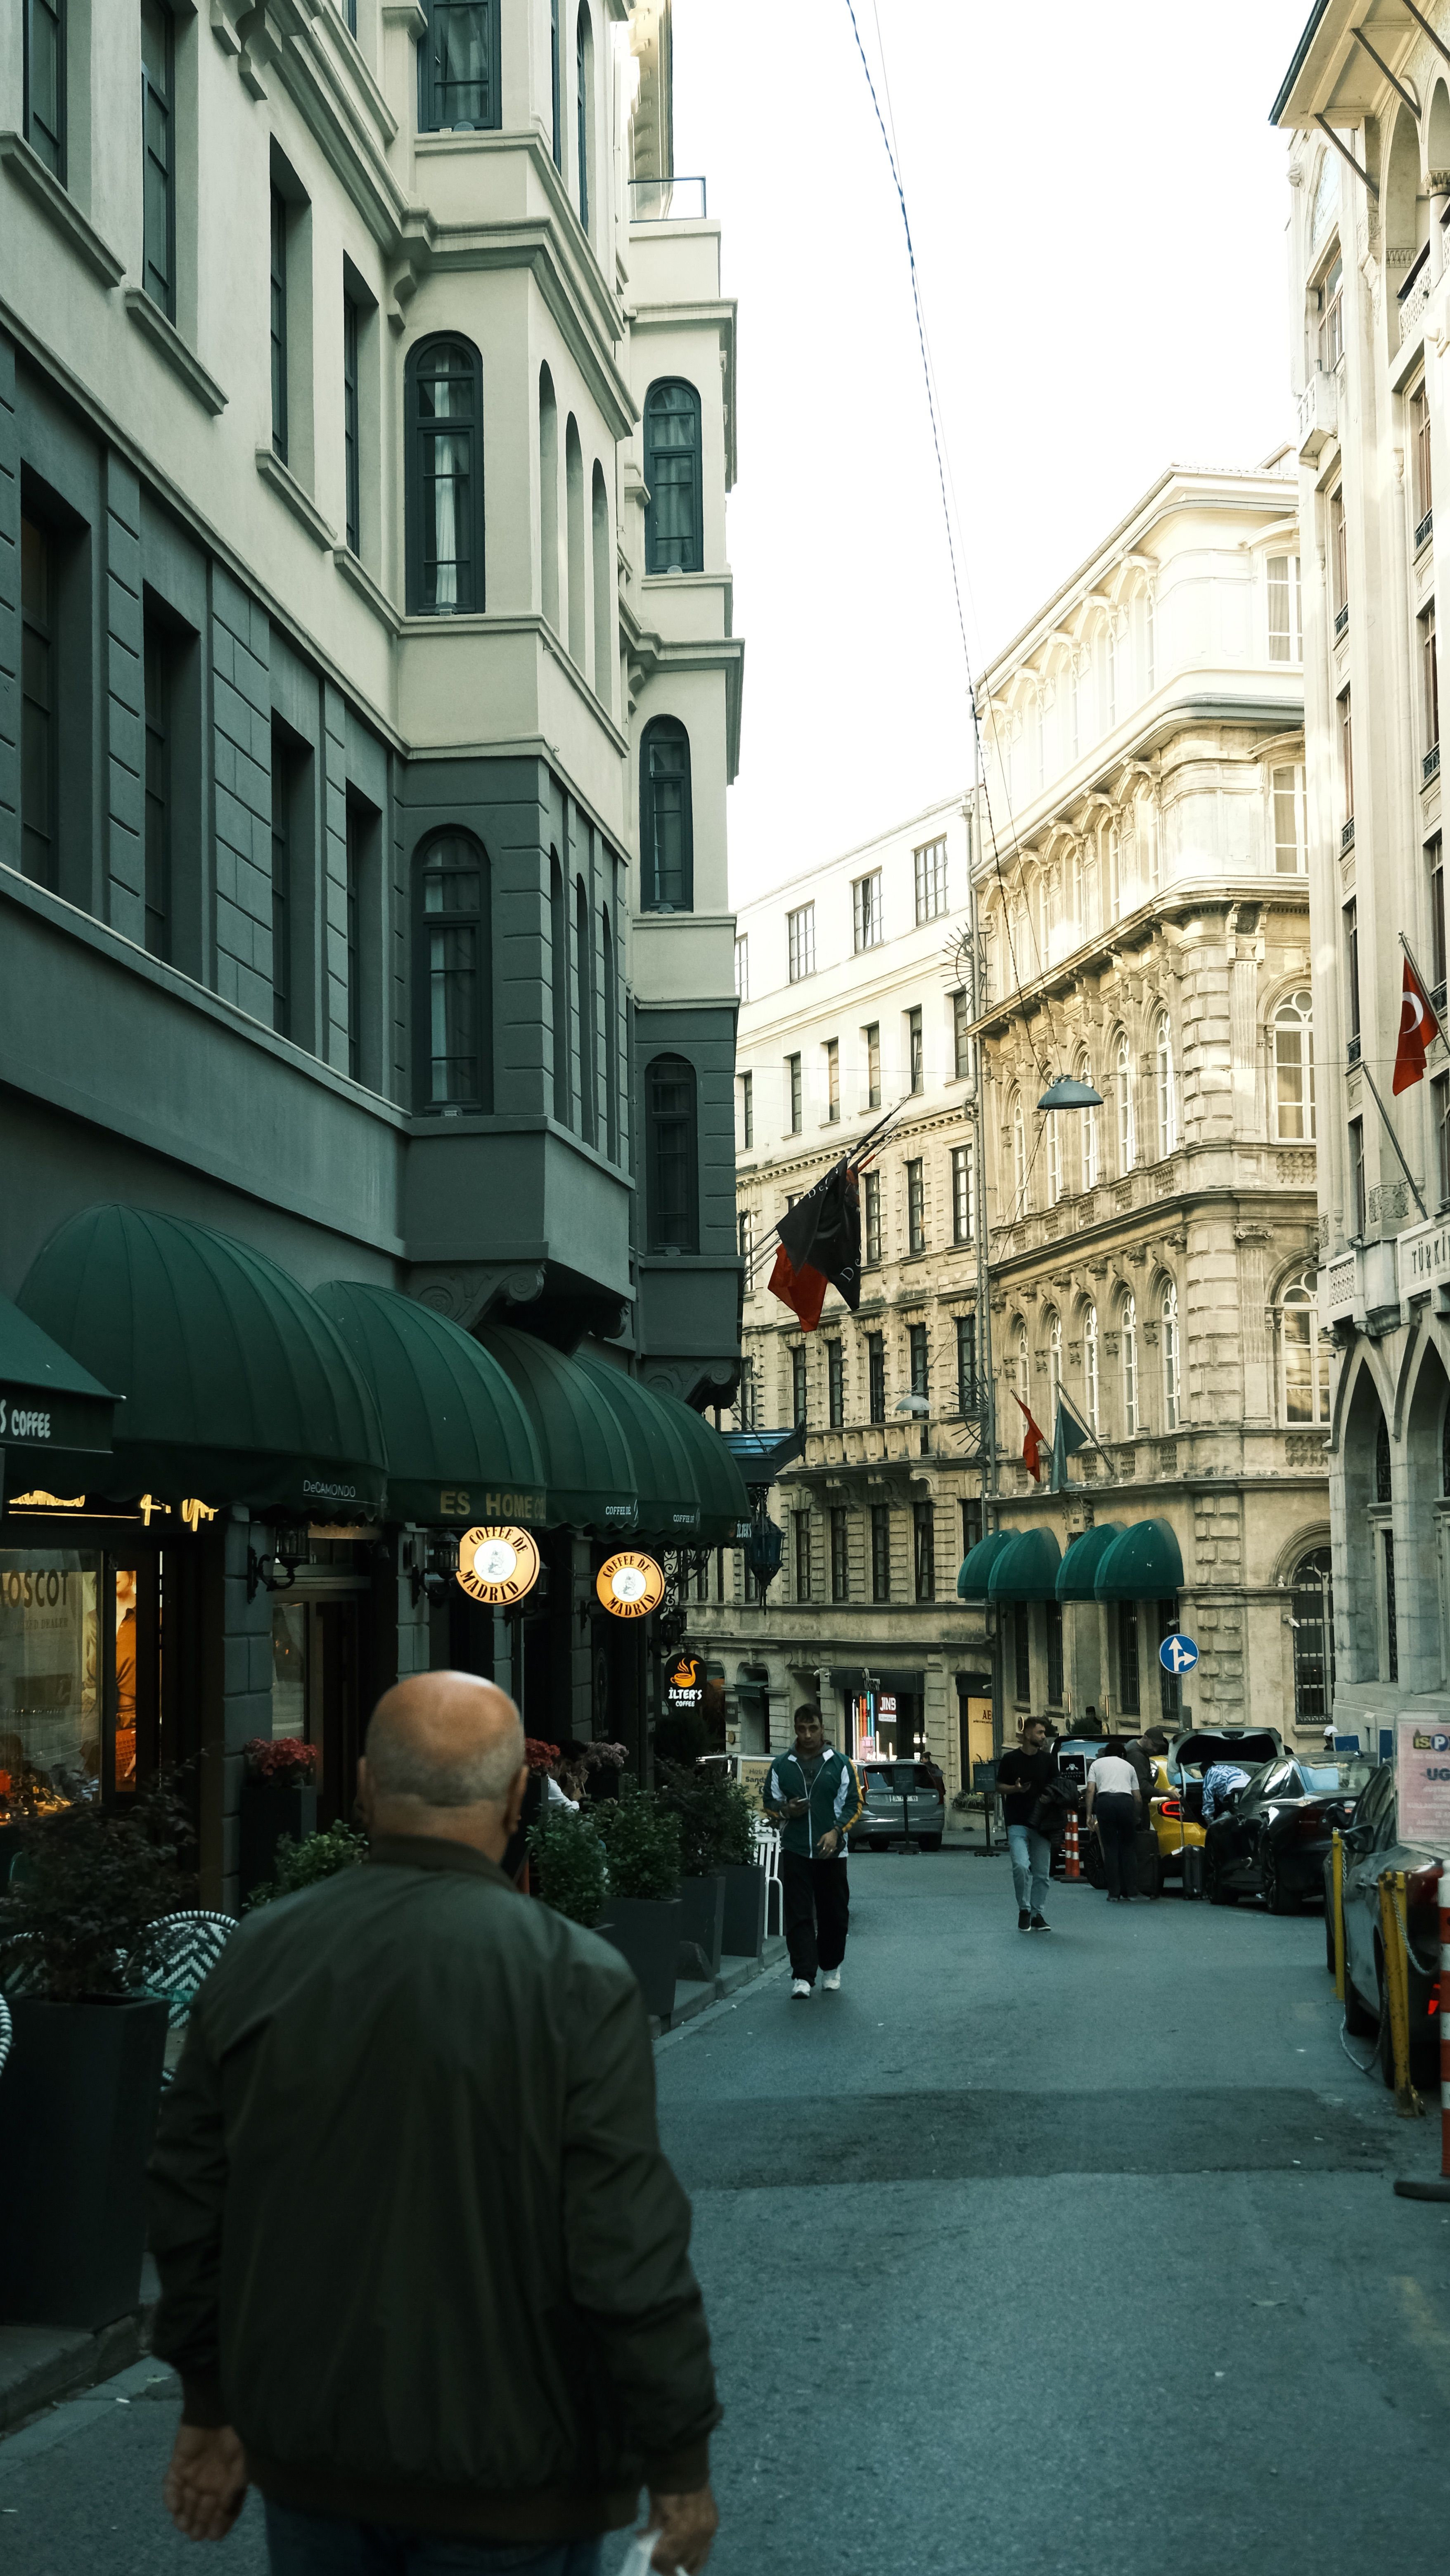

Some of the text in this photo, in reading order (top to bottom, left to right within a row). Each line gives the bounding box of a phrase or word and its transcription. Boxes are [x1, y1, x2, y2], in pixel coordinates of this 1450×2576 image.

[11, 1409, 50, 1438] COFFEE
[303, 1480, 356, 1497] DeCAMONDO
[440, 1490, 471, 1515] ES
[486, 1493, 533, 1518] HOME
[606, 1506, 625, 1515] COFFEE
[673, 1514, 690, 1522] COFFEE
[469, 1527, 509, 1545] COFFEE
[603, 1556, 635, 1578] COFFEE
[982, 1709, 992, 1720] AE
